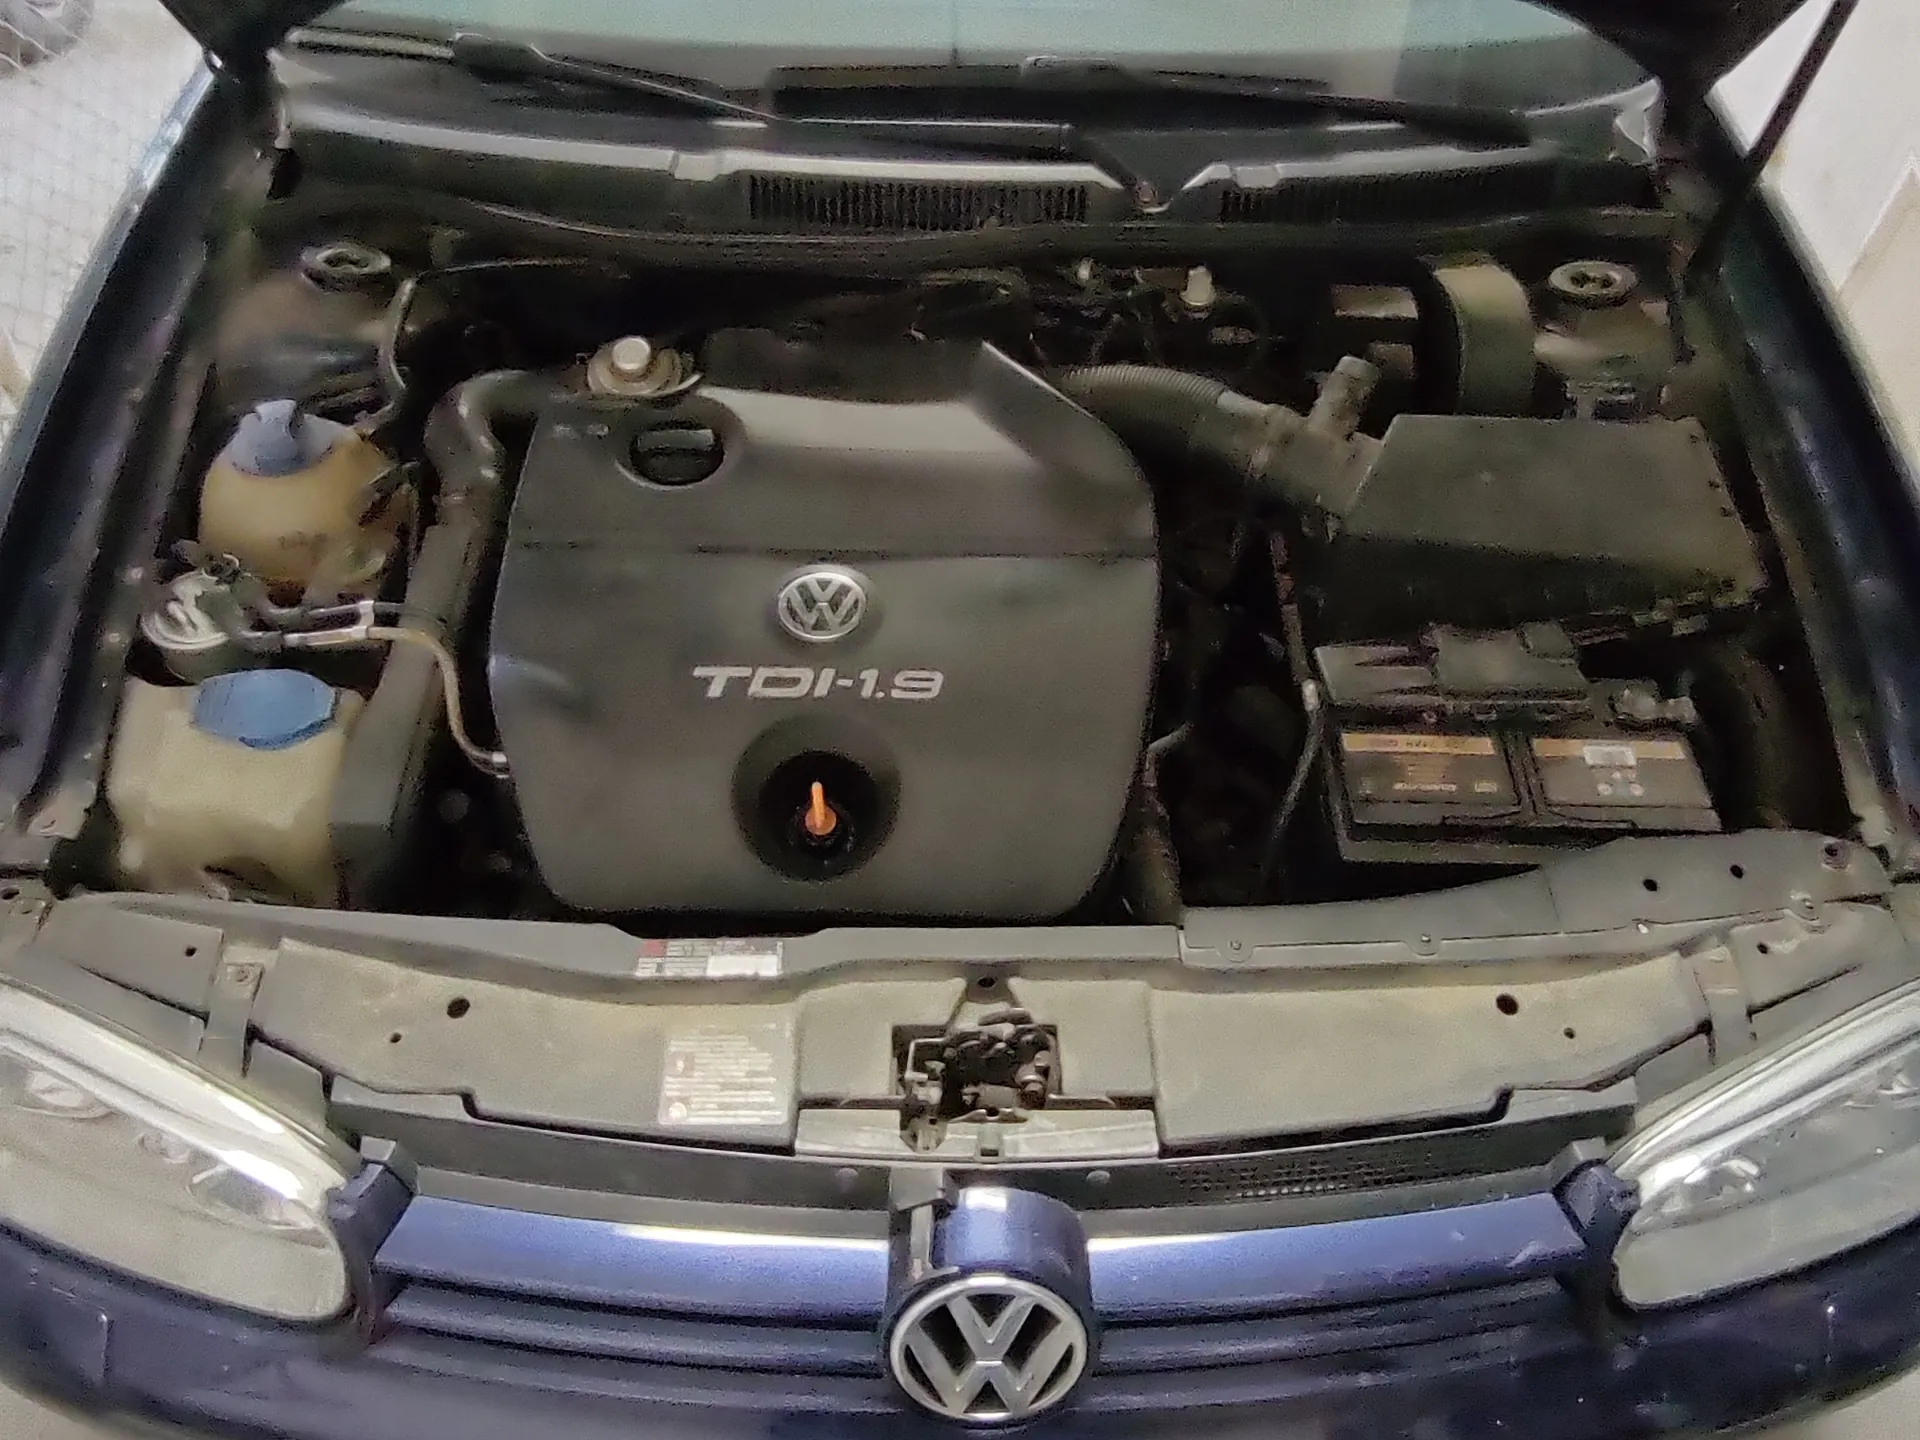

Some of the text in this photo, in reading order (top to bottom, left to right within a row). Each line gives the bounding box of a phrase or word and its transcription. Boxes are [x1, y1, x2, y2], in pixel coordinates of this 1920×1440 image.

[781, 574, 863, 638] VW
[693, 666, 944, 699] TDI-1.9
[896, 1288, 1079, 1416] VW
